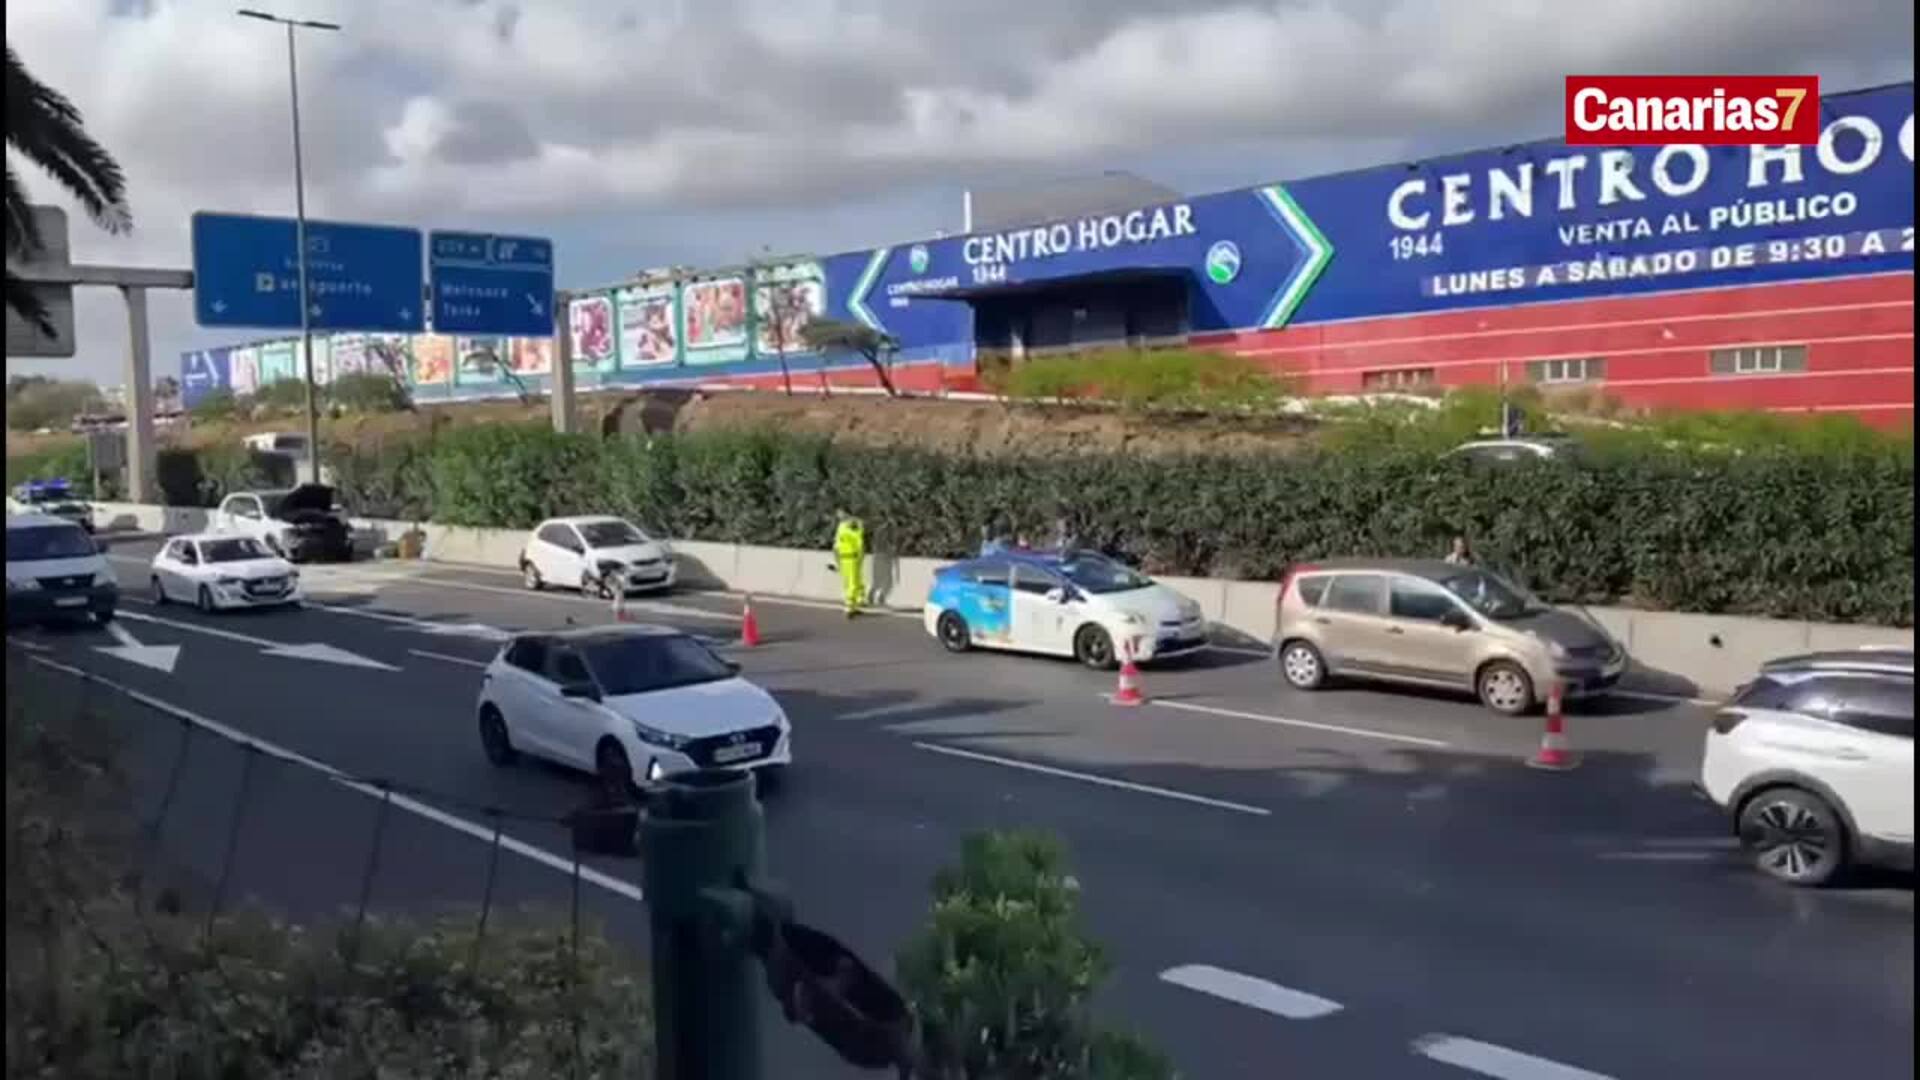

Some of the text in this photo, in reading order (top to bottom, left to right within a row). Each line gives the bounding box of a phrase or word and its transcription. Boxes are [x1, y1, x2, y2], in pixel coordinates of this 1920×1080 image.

[1388, 115, 1915, 230] CENTRO HO
[963, 204, 1196, 265] CENTRO HOGAR
[1389, 231, 1444, 260] 1944
[1558, 191, 1857, 247] VENTA AL PÚBLICO
[1432, 267, 1526, 296] LUNES
[1535, 264, 1557, 287] A
[1567, 249, 1697, 283] SÁBADO
[1710, 243, 1756, 269] DE
[1769, 233, 1846, 262] 9:30
[1860, 231, 1885, 255] A
